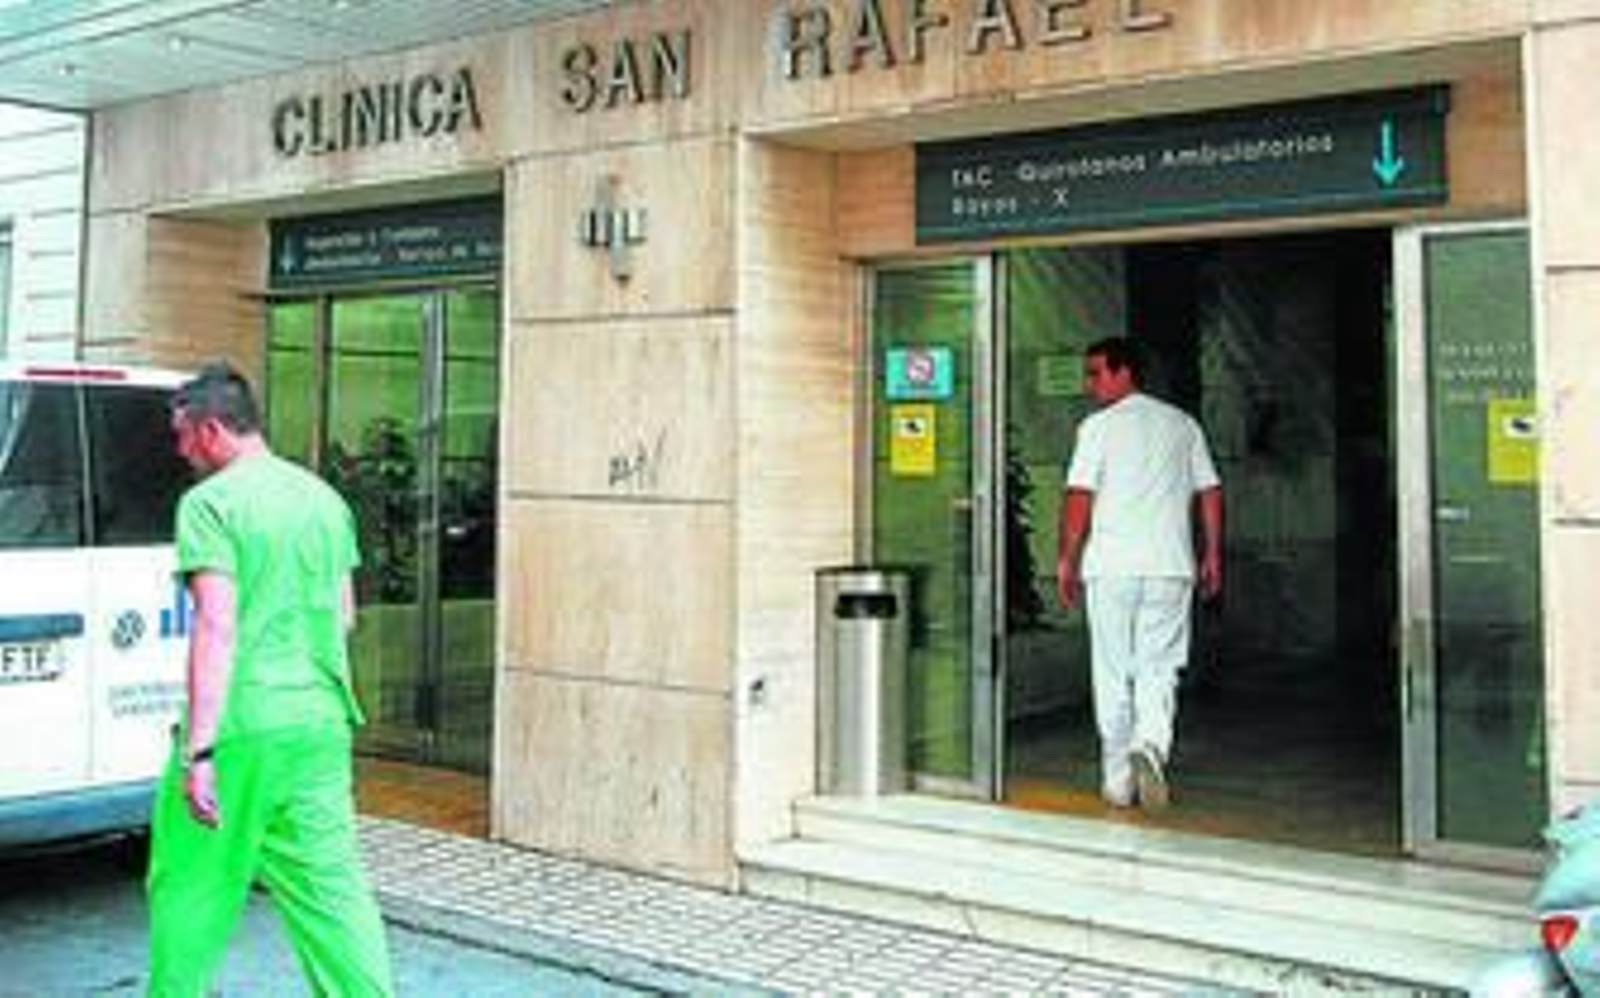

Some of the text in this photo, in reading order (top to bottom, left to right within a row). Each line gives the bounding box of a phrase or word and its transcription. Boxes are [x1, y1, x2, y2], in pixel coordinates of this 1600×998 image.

[271, 67, 482, 157] CLINICA
[562, 30, 692, 113] SAN
[1161, 134, 1333, 167] Ambulatorios
[1053, 188, 1070, 208] X
